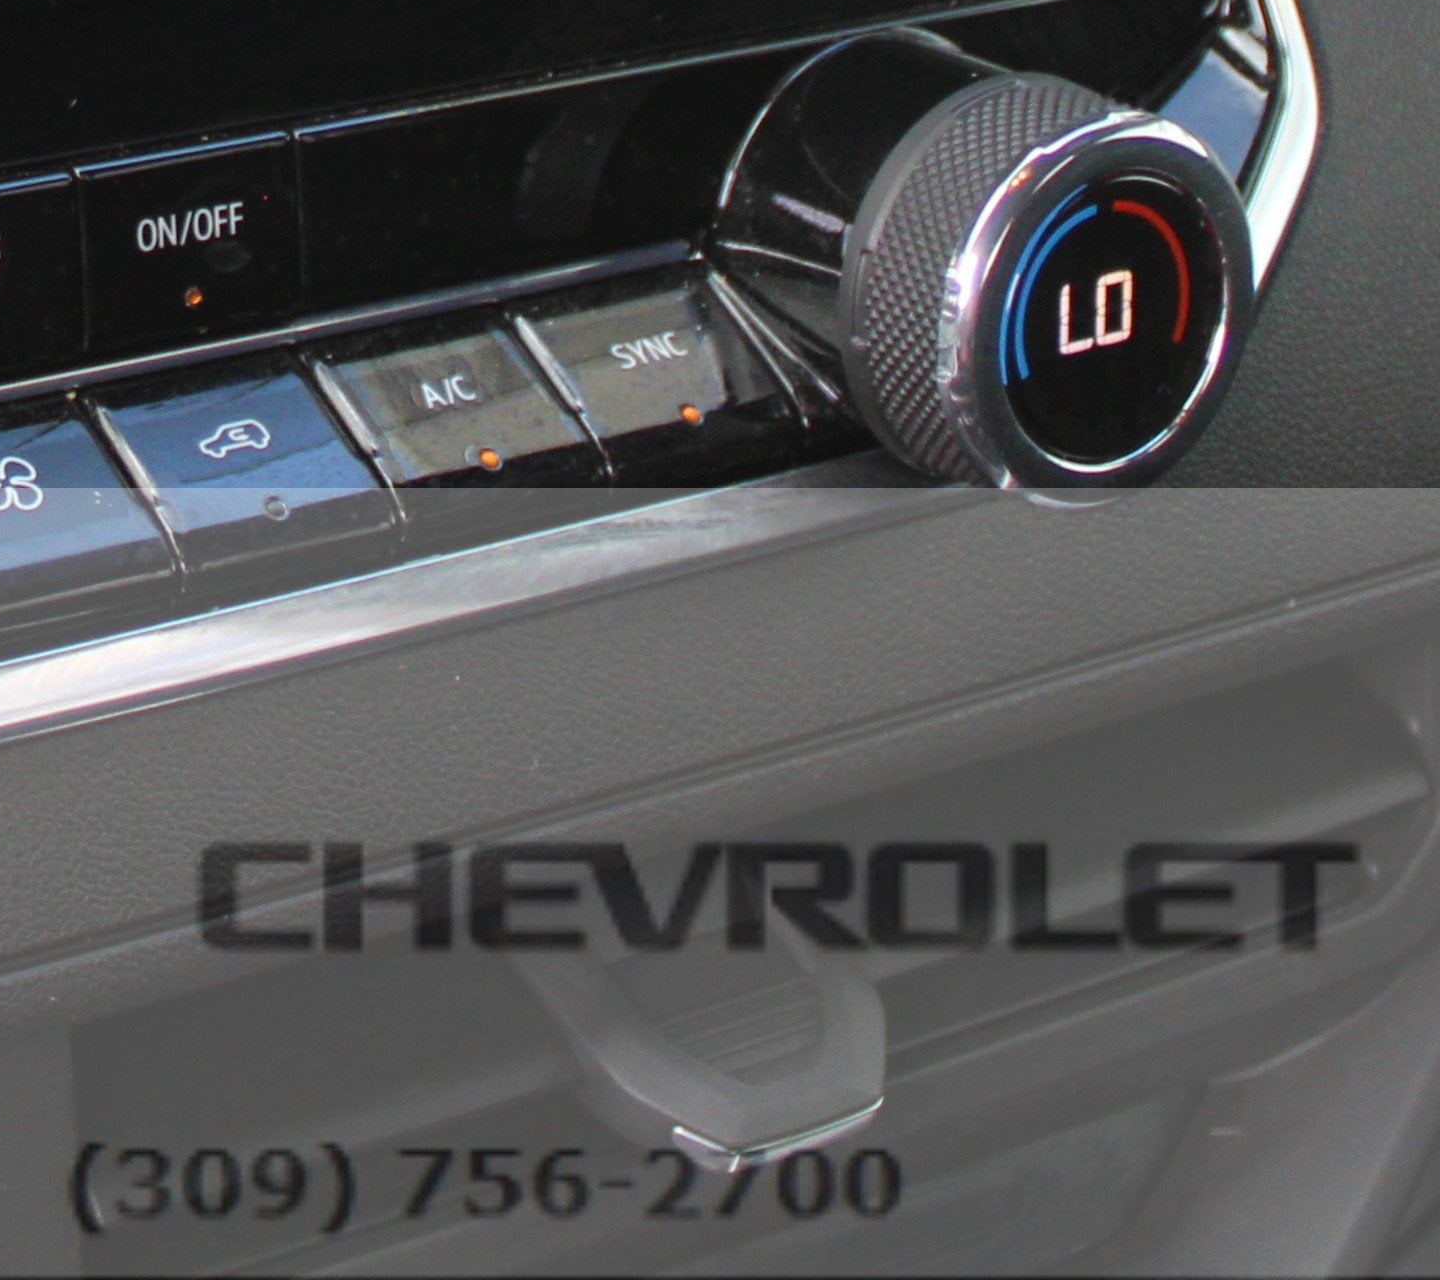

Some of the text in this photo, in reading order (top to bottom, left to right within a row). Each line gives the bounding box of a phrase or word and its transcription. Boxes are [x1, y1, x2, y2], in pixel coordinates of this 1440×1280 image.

[136, 200, 245, 254] ON/OFF
[1058, 269, 1133, 355] LO
[610, 331, 689, 371] SYNC
[420, 373, 477, 411] A/C
